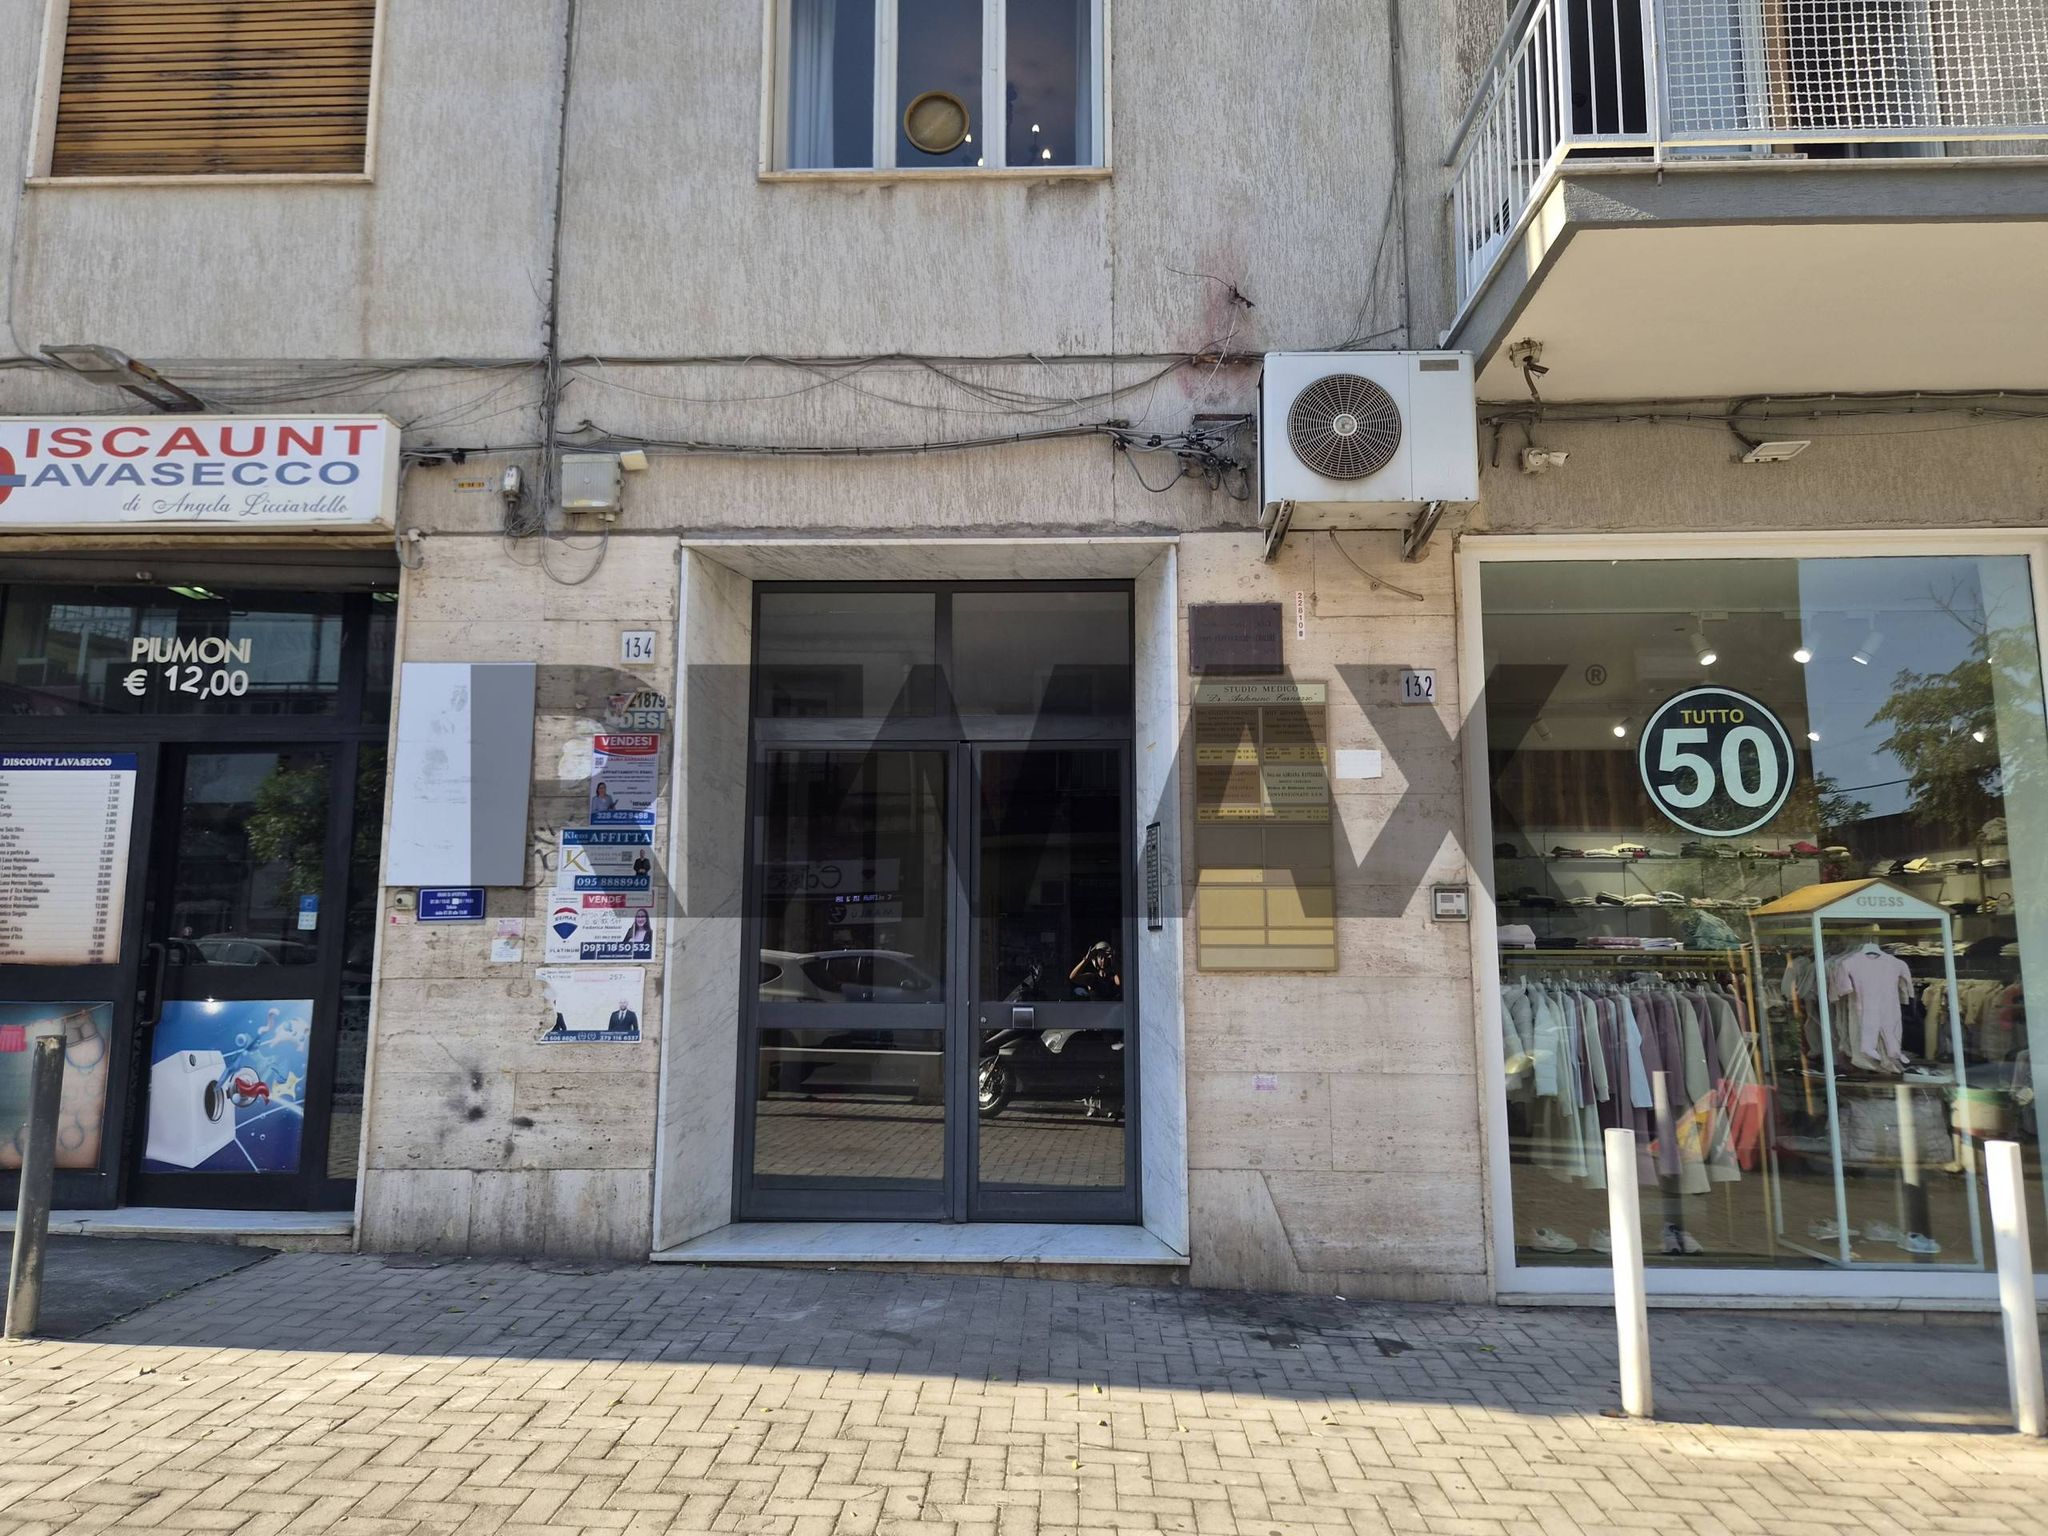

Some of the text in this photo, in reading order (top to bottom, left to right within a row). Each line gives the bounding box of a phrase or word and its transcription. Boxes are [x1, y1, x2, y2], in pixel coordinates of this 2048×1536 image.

[0, 424, 379, 459] ISCAUNT
[122, 496, 141, 512] di
[152, 493, 231, 521] Angela
[131, 637, 252, 664] PIUMONI
[625, 637, 653, 659] 134
[123, 665, 249, 700] € 12,00
[1262, 685, 1299, 693] MEDICO
[1405, 675, 1433, 698] 132
[1680, 708, 1745, 724] TUTTO
[601, 736, 653, 746] VENDESI
[2, 757, 112, 767] DISCOUNT LAVASECCO
[1657, 725, 1779, 809] 50
[590, 832, 651, 843] AFFITTA
[577, 877, 598, 887] 095
[1856, 896, 1905, 908] GUESS
